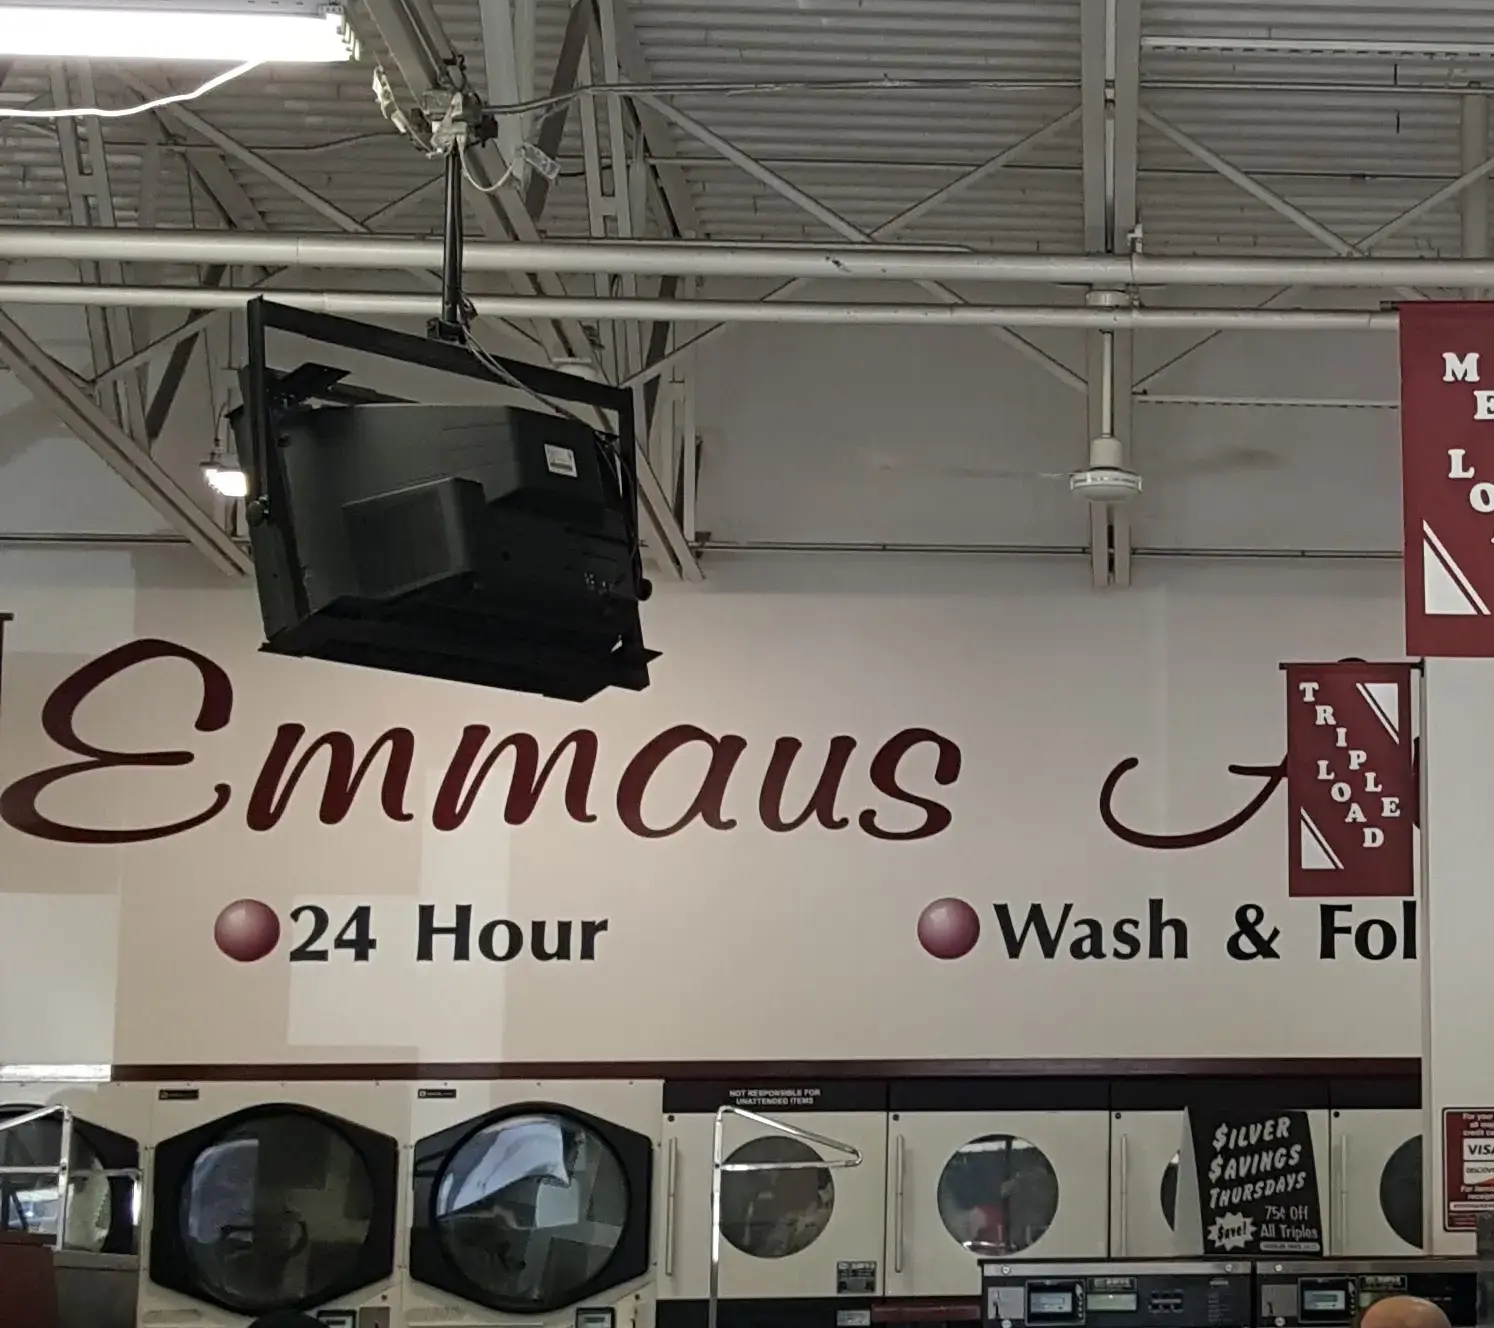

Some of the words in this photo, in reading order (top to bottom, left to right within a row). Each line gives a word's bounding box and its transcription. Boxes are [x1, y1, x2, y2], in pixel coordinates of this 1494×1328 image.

[0, 638, 962, 844] Emmaus
[1298, 681, 1401, 818] TRIPLE
[1316, 760, 1385, 848] LOAD
[288, 904, 376, 962] 24
[416, 903, 608, 962] Hour
[993, 898, 1188, 960] Wash
[1226, 902, 1281, 960] &
[1319, 900, 1417, 960] Fol
[729, 1089, 746, 1097] NOT
[748, 1088, 802, 1097] RESPONSIBLE
[804, 1088, 821, 1096] FOR
[736, 1097, 789, 1105] UNATTENDED
[790, 1097, 814, 1105] ITEMS
[1209, 1171, 1307, 1209] THURSDAYS
[1260, 1223, 1276, 1238] All
[1279, 1223, 1318, 1241] Triples
